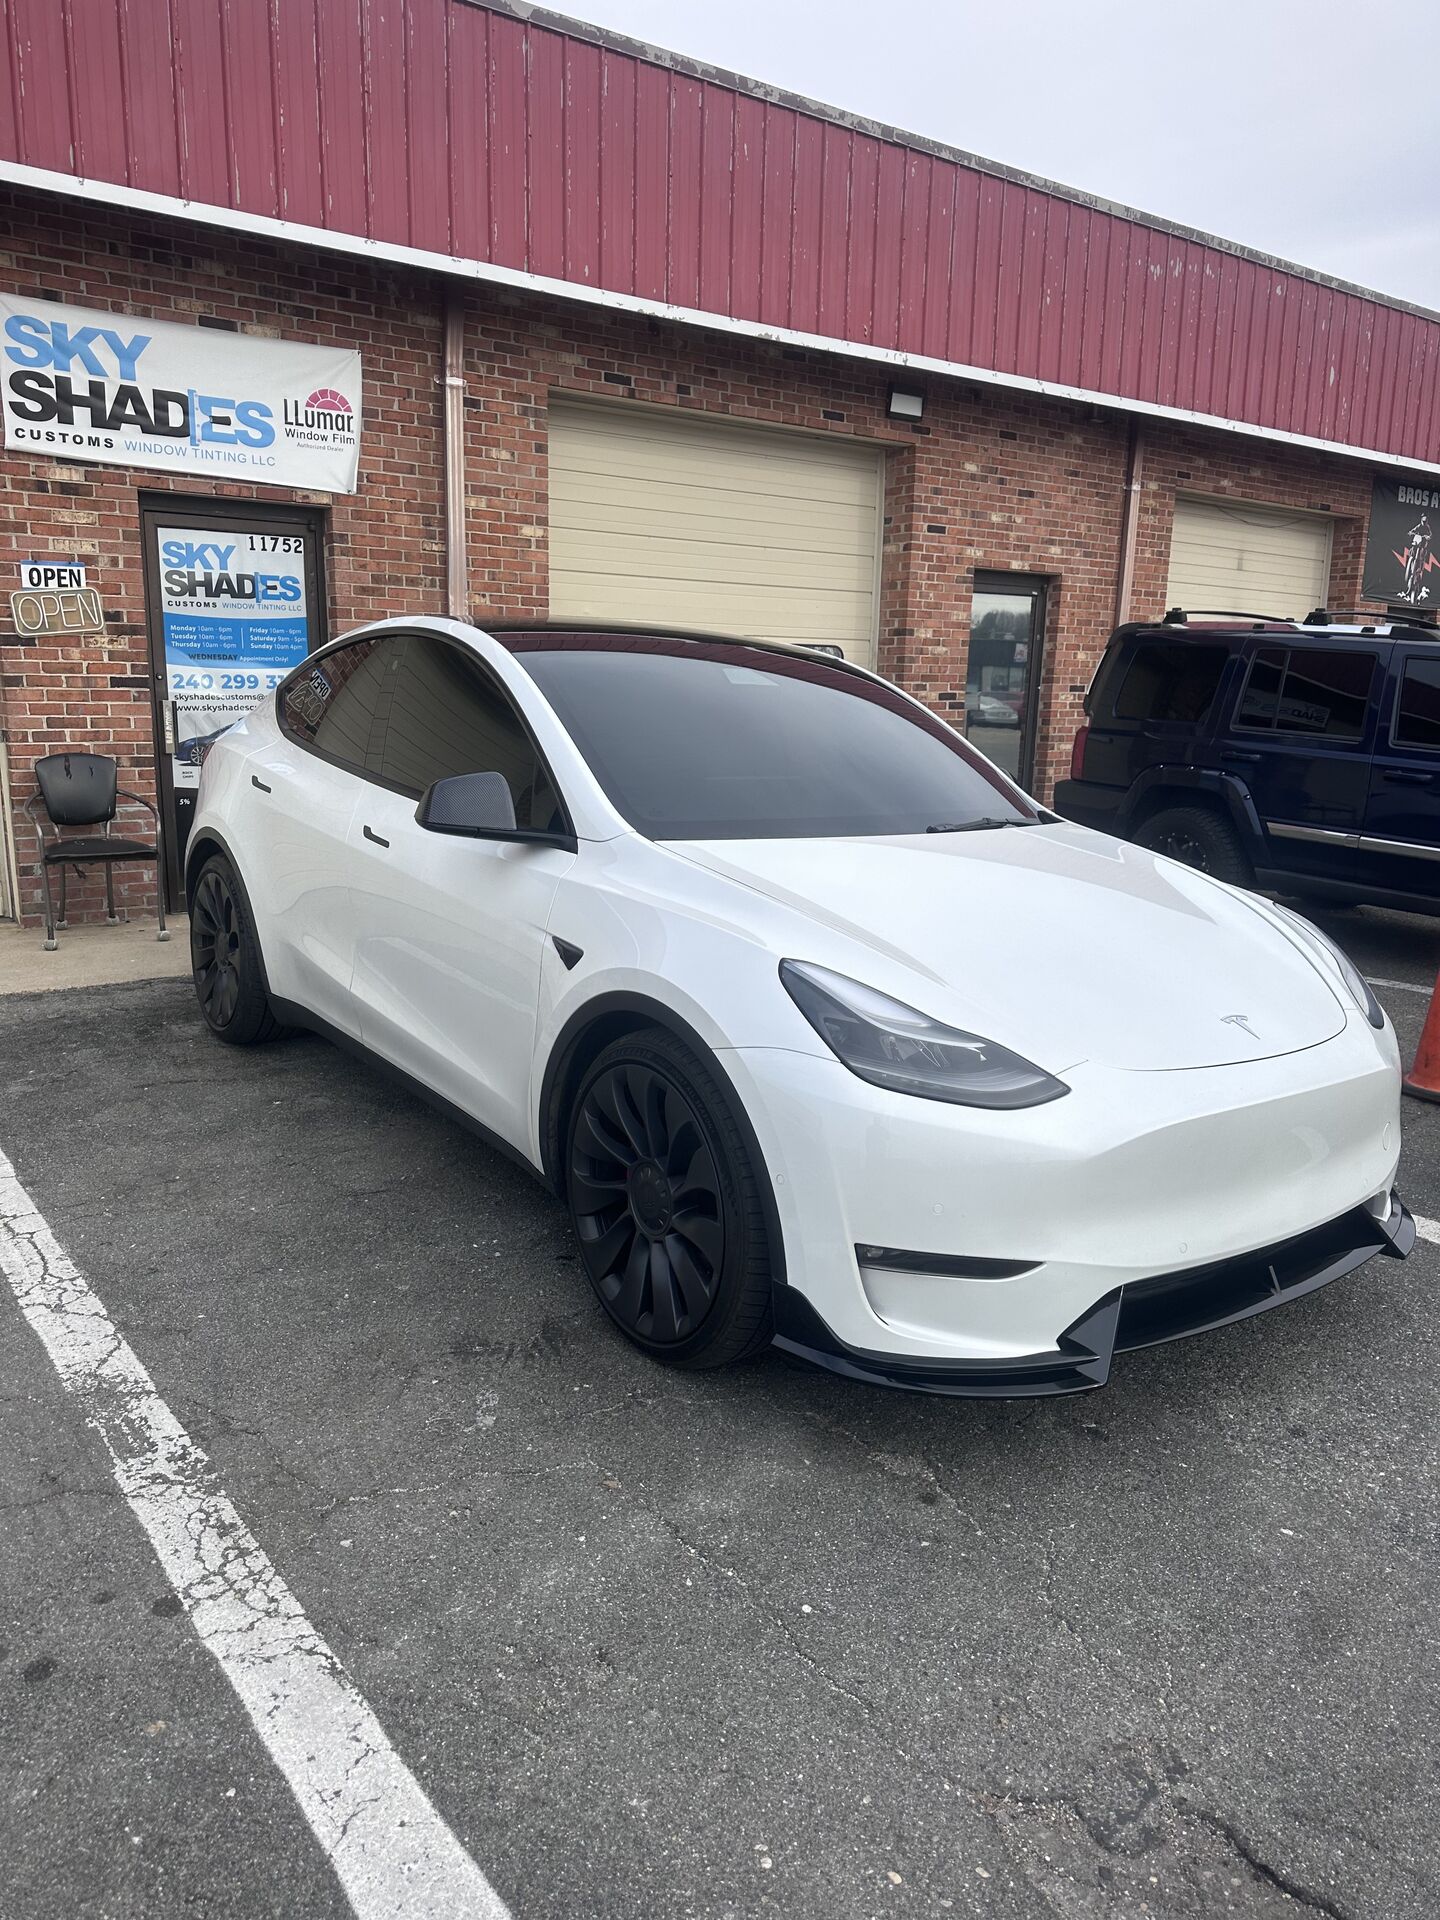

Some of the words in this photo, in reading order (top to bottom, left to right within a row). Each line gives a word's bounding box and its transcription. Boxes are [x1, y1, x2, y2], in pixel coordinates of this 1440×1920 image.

[4, 314, 152, 381] SKY
[8, 370, 275, 448] SHADES
[284, 428, 328, 442] Window
[332, 433, 355, 445] Film
[15, 427, 114, 448] CUSTOMS
[125, 440, 187, 457] WINDOW
[192, 448, 247, 463] TINTING
[252, 454, 276, 467] LLC
[1398, 485, 1430, 506] BROS
[1431, 492, 1440, 508] A
[249, 536, 303, 554] 11752
[162, 540, 236, 571] SKY
[28, 567, 82, 588] OPEN
[164, 569, 302, 603] SHADES
[18, 592, 99, 630] OPEN
[167, 600, 218, 609] CUSTOMS
[222, 602, 255, 610] WINDOW
[170, 625, 197, 633] Monday
[170, 633, 197, 641] Tuesday
[249, 627, 269, 635] Friday
[171, 641, 201, 649] Thursday
[188, 653, 238, 661] WEDNESDAY
[172, 673, 214, 690] 240
[220, 674, 259, 690] 299
[174, 694, 269, 702] skyshadescustoms@
[175, 703, 257, 712] www.skyshadesc
